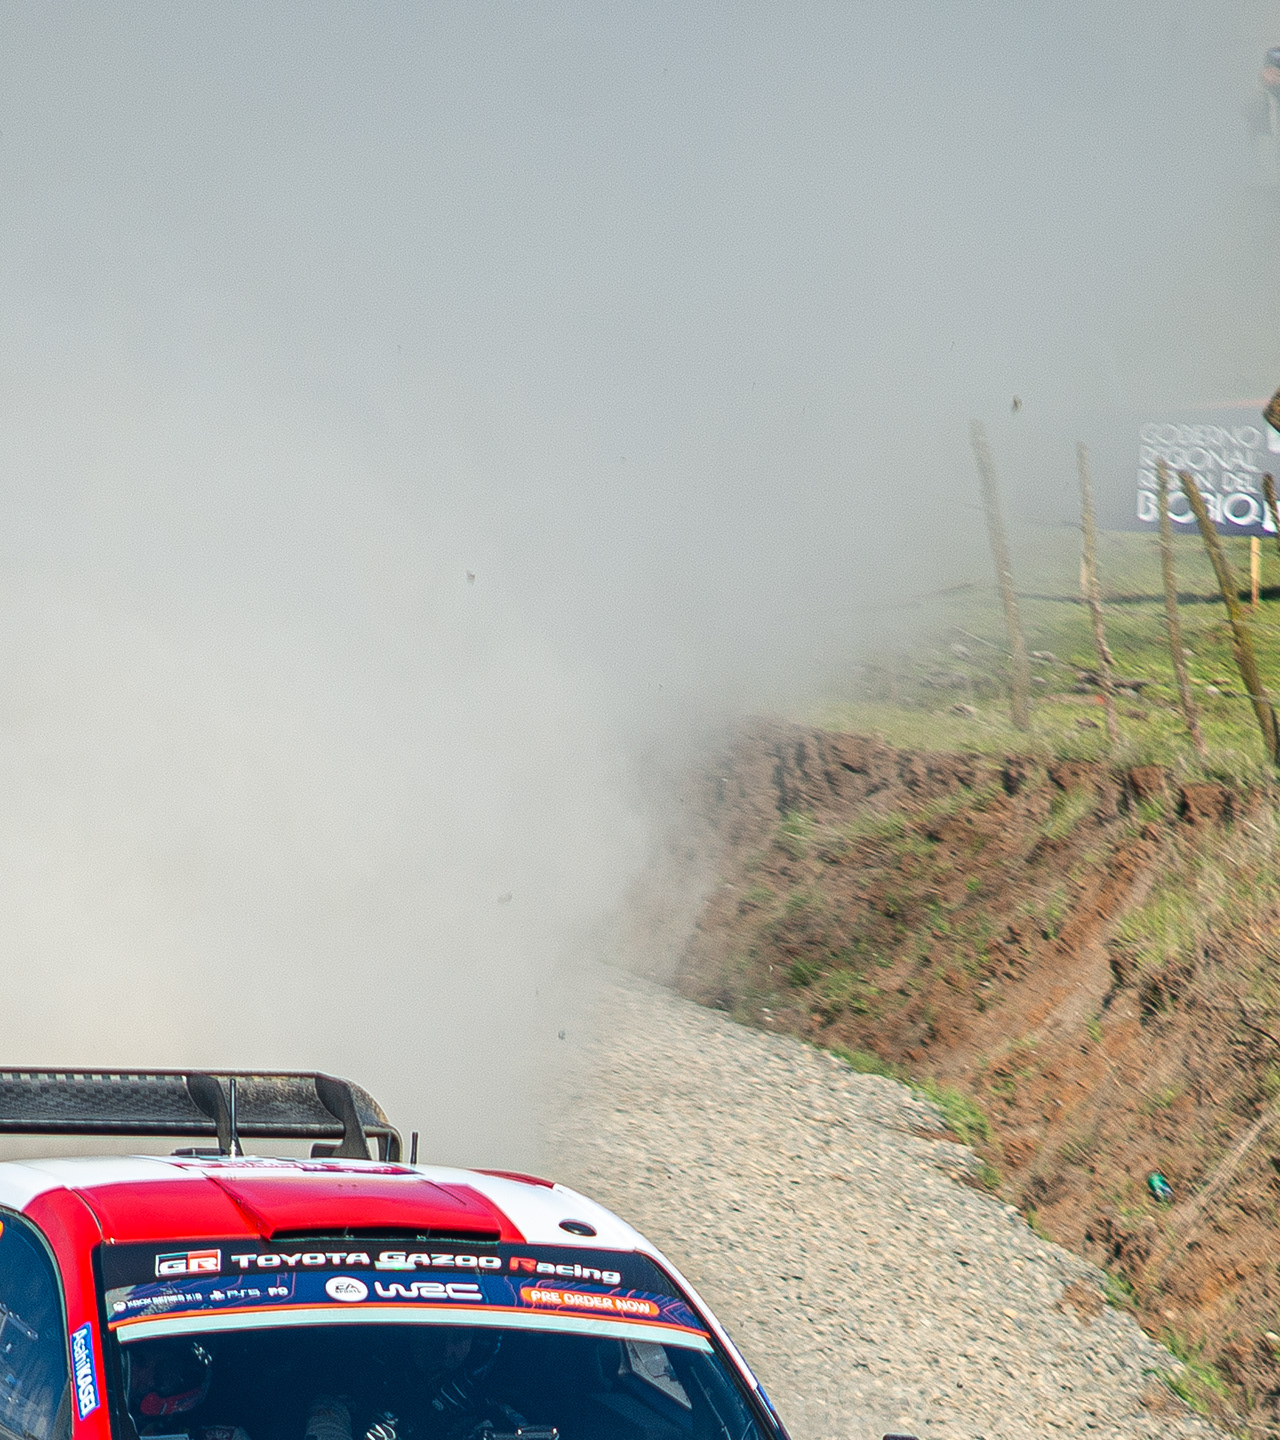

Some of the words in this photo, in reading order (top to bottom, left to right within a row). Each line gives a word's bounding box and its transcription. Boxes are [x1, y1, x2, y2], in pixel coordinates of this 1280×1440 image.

[158, 1255, 220, 1274] GR
[230, 1252, 371, 1269] TOYOTA
[378, 1251, 502, 1269] GAZOO
[508, 1256, 622, 1286] Racing
[531, 1289, 556, 1304] PRE
[564, 1293, 614, 1309] ORDER
[617, 1299, 651, 1314] NOW
